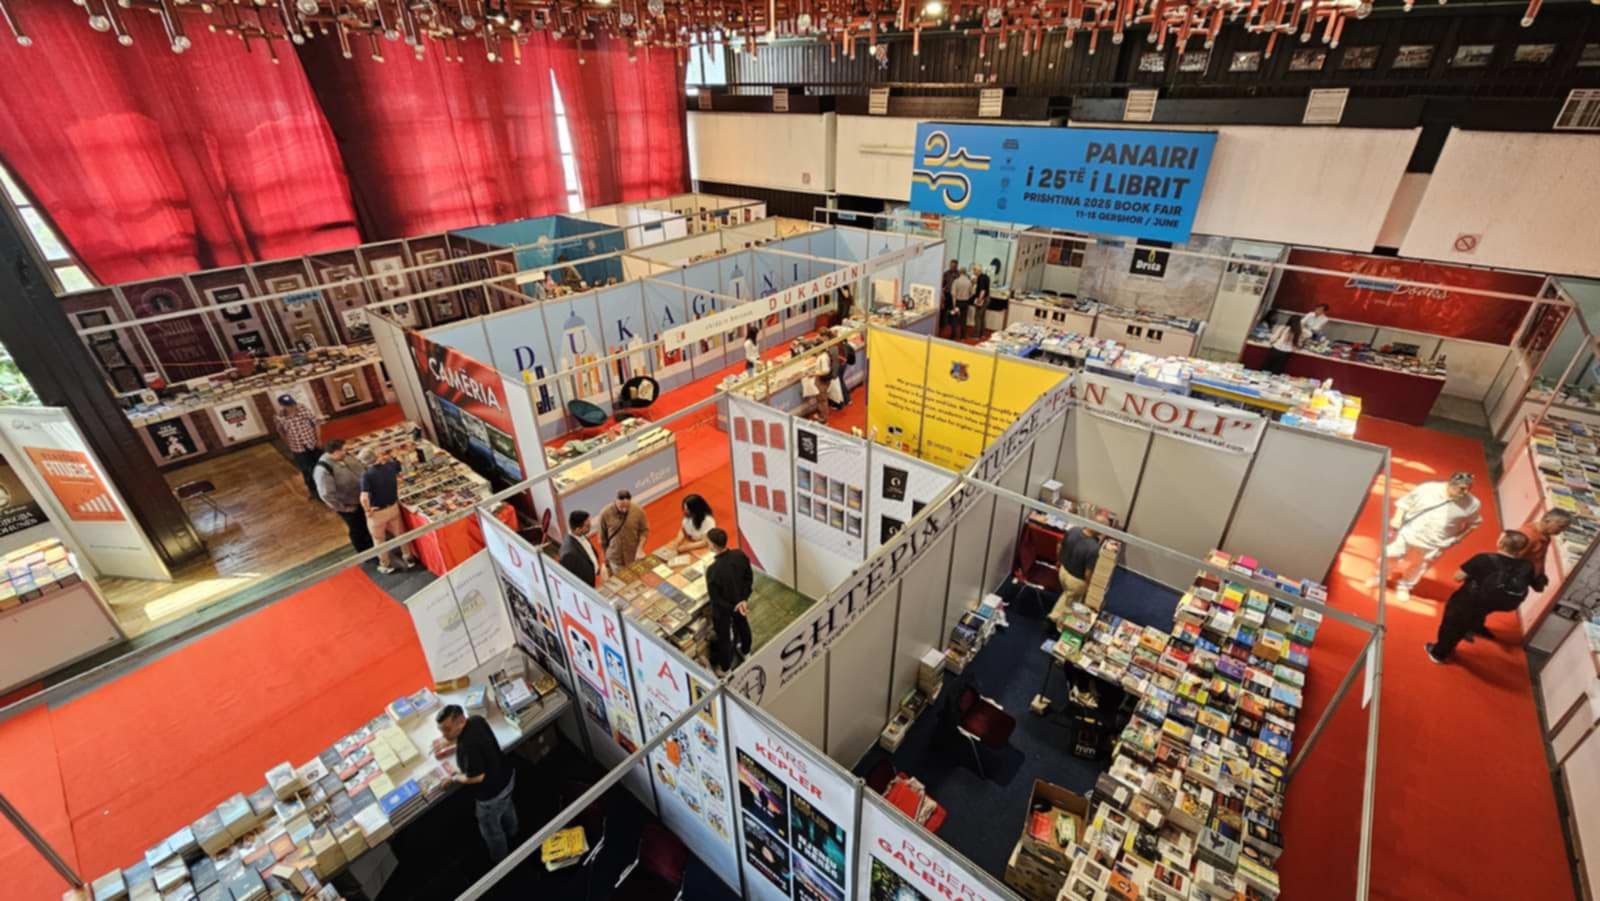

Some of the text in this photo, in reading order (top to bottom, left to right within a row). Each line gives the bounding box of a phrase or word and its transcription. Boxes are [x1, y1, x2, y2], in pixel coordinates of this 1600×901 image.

[1085, 142, 1199, 170] PANAIRI
[1103, 174, 1190, 199] LIBRIT
[1024, 192, 1182, 217] PRISHTINA 2025 BOOK FAIR
[1153, 217, 1179, 228] JUNE
[1135, 258, 1161, 272] Drita
[769, 263, 866, 310] DUKAGJINI
[779, 515, 939, 676] SHTËPIA
[949, 408, 1041, 512] BOTUESE
[509, 543, 680, 692] DITURIA
[755, 741, 823, 800] KEPLER
[766, 735, 808, 774] LARS
